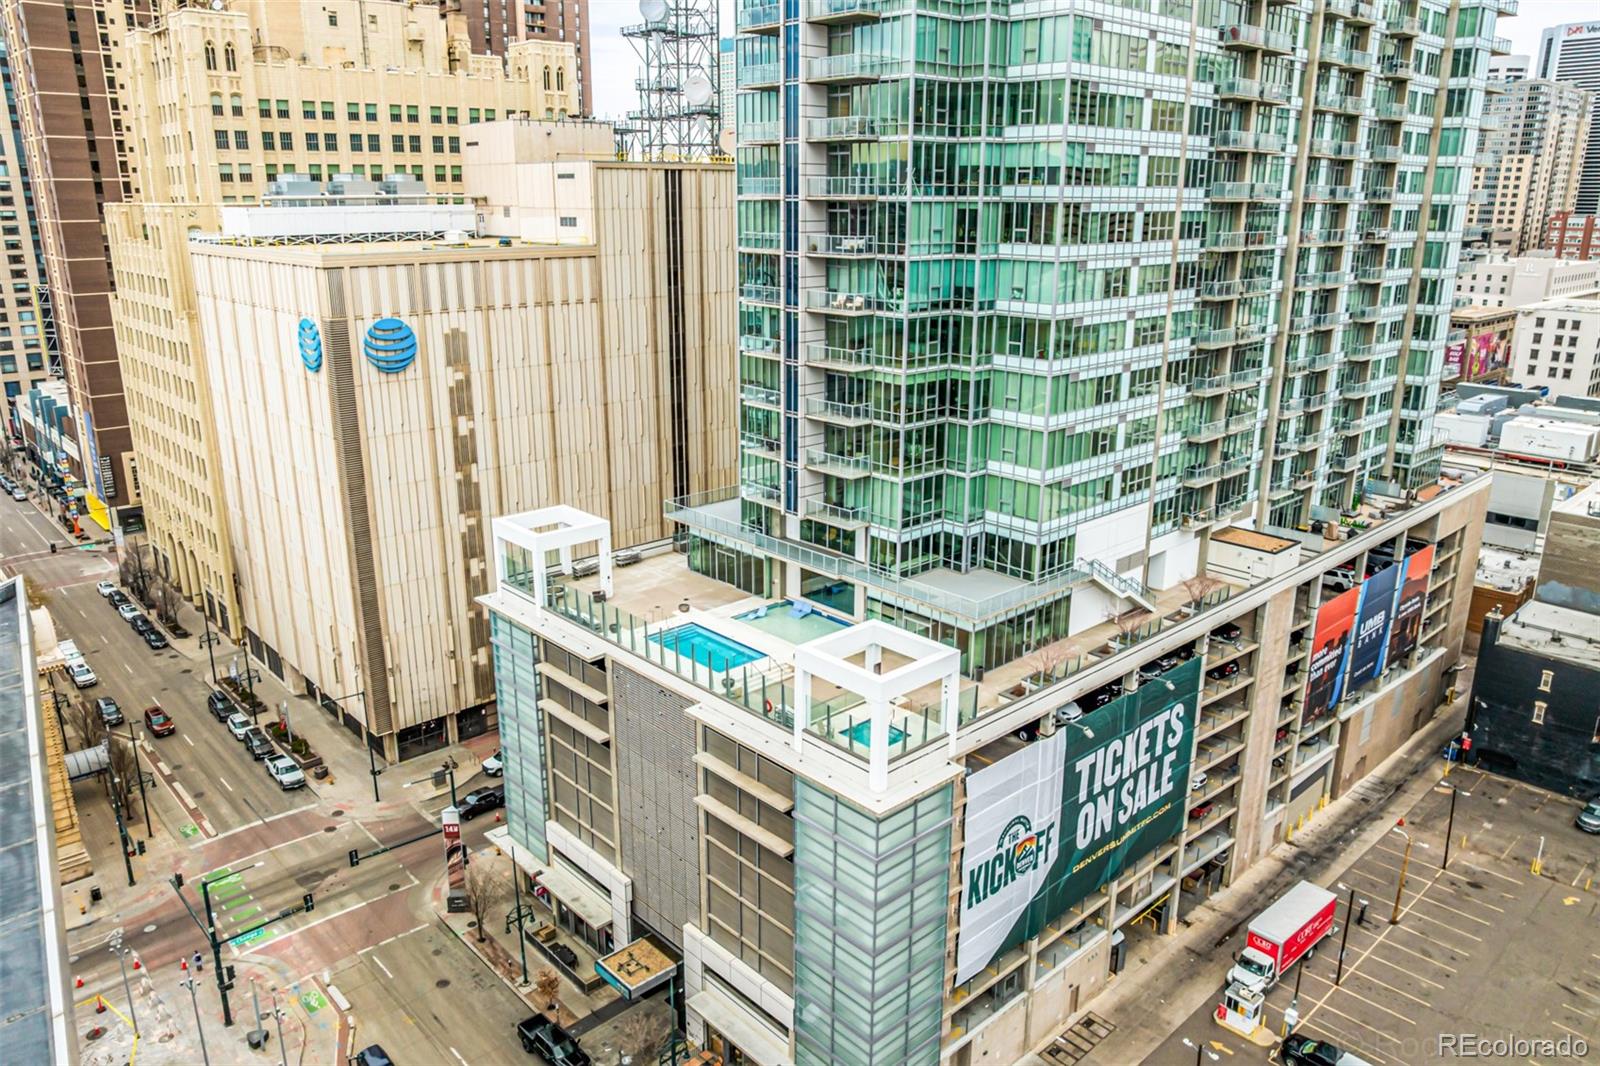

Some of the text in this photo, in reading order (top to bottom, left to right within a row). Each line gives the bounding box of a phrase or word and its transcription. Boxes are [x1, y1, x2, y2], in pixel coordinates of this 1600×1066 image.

[1360, 610, 1386, 635] UMB
[1357, 626, 1384, 649] BANK
[1311, 644, 1343, 671] committed
[1075, 703, 1185, 805] TICKETS
[1076, 788, 1115, 850] ON
[1118, 750, 1177, 825] SALE
[1008, 829, 1020, 844] THE
